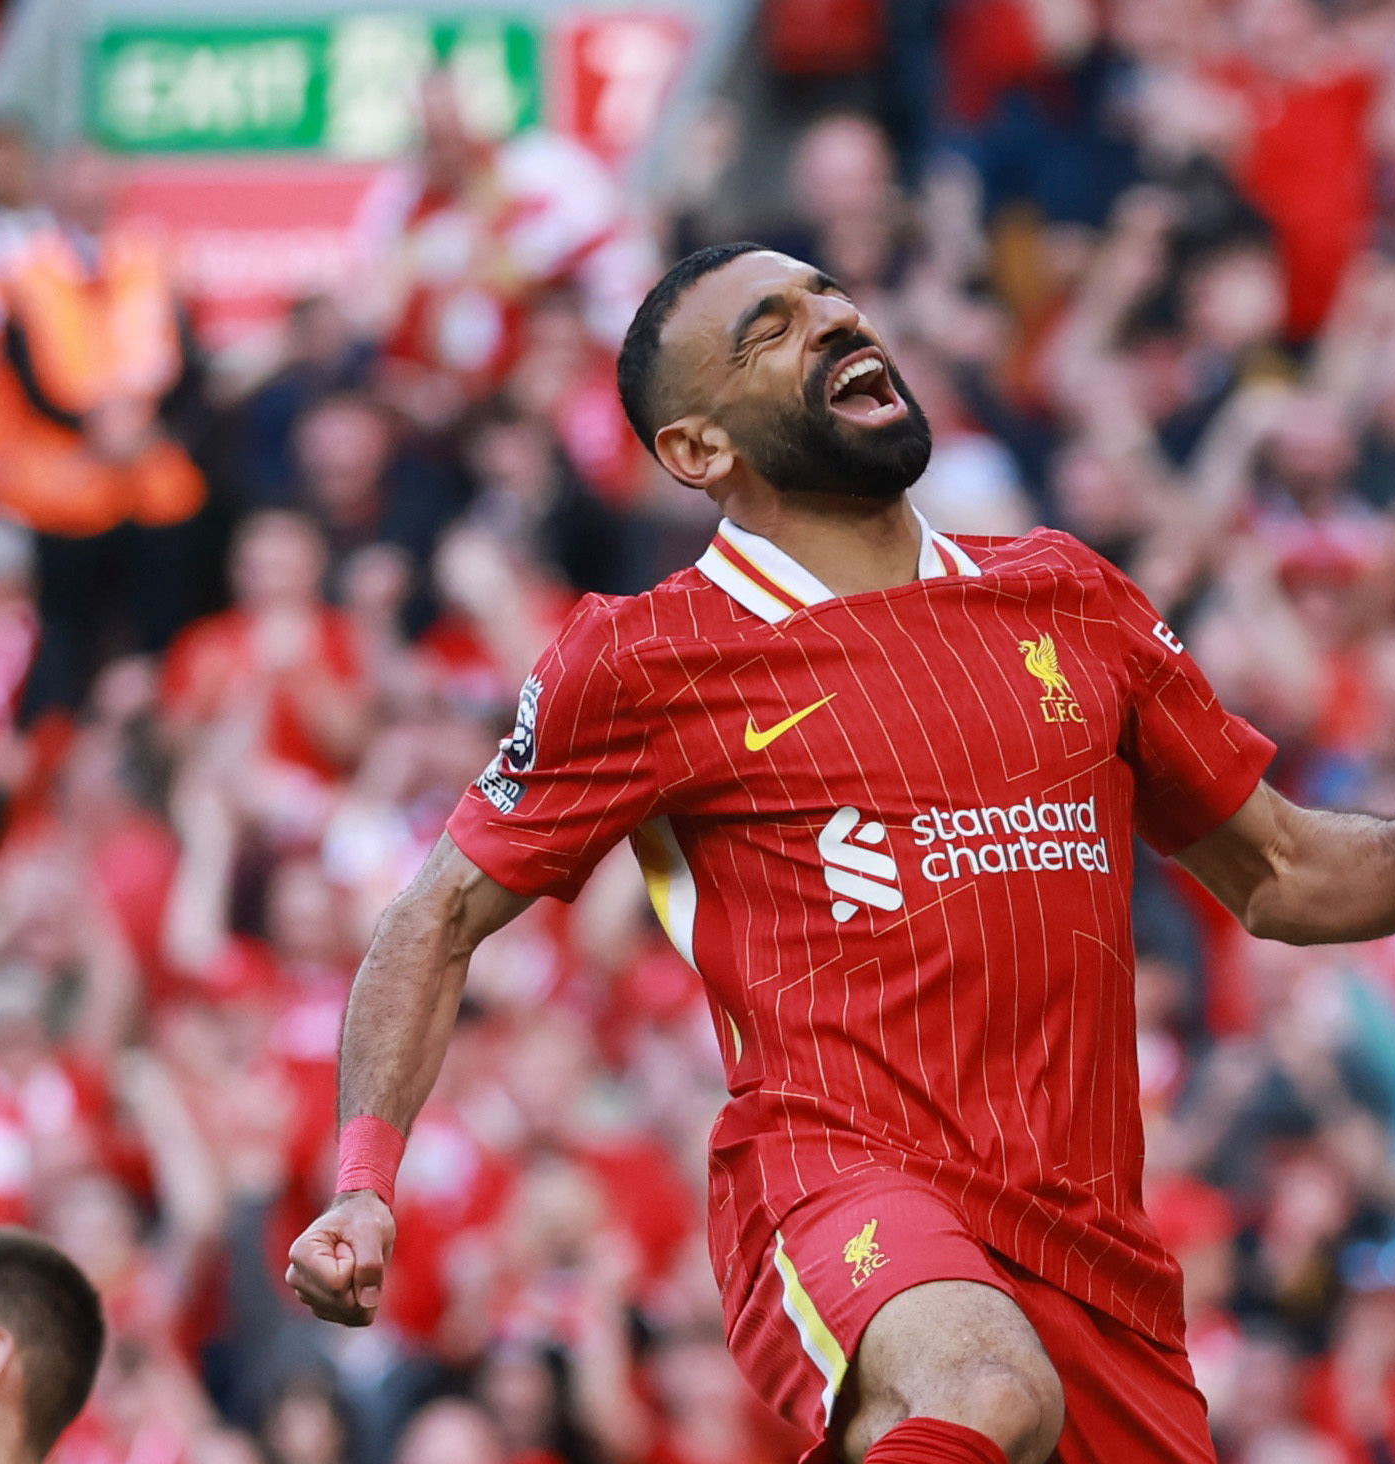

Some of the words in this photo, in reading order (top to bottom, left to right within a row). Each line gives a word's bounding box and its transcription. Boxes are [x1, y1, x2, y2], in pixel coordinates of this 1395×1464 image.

[1040, 703, 1087, 723] L.F.C.
[911, 796, 1097, 846] standard
[921, 836, 1110, 882] chartered
